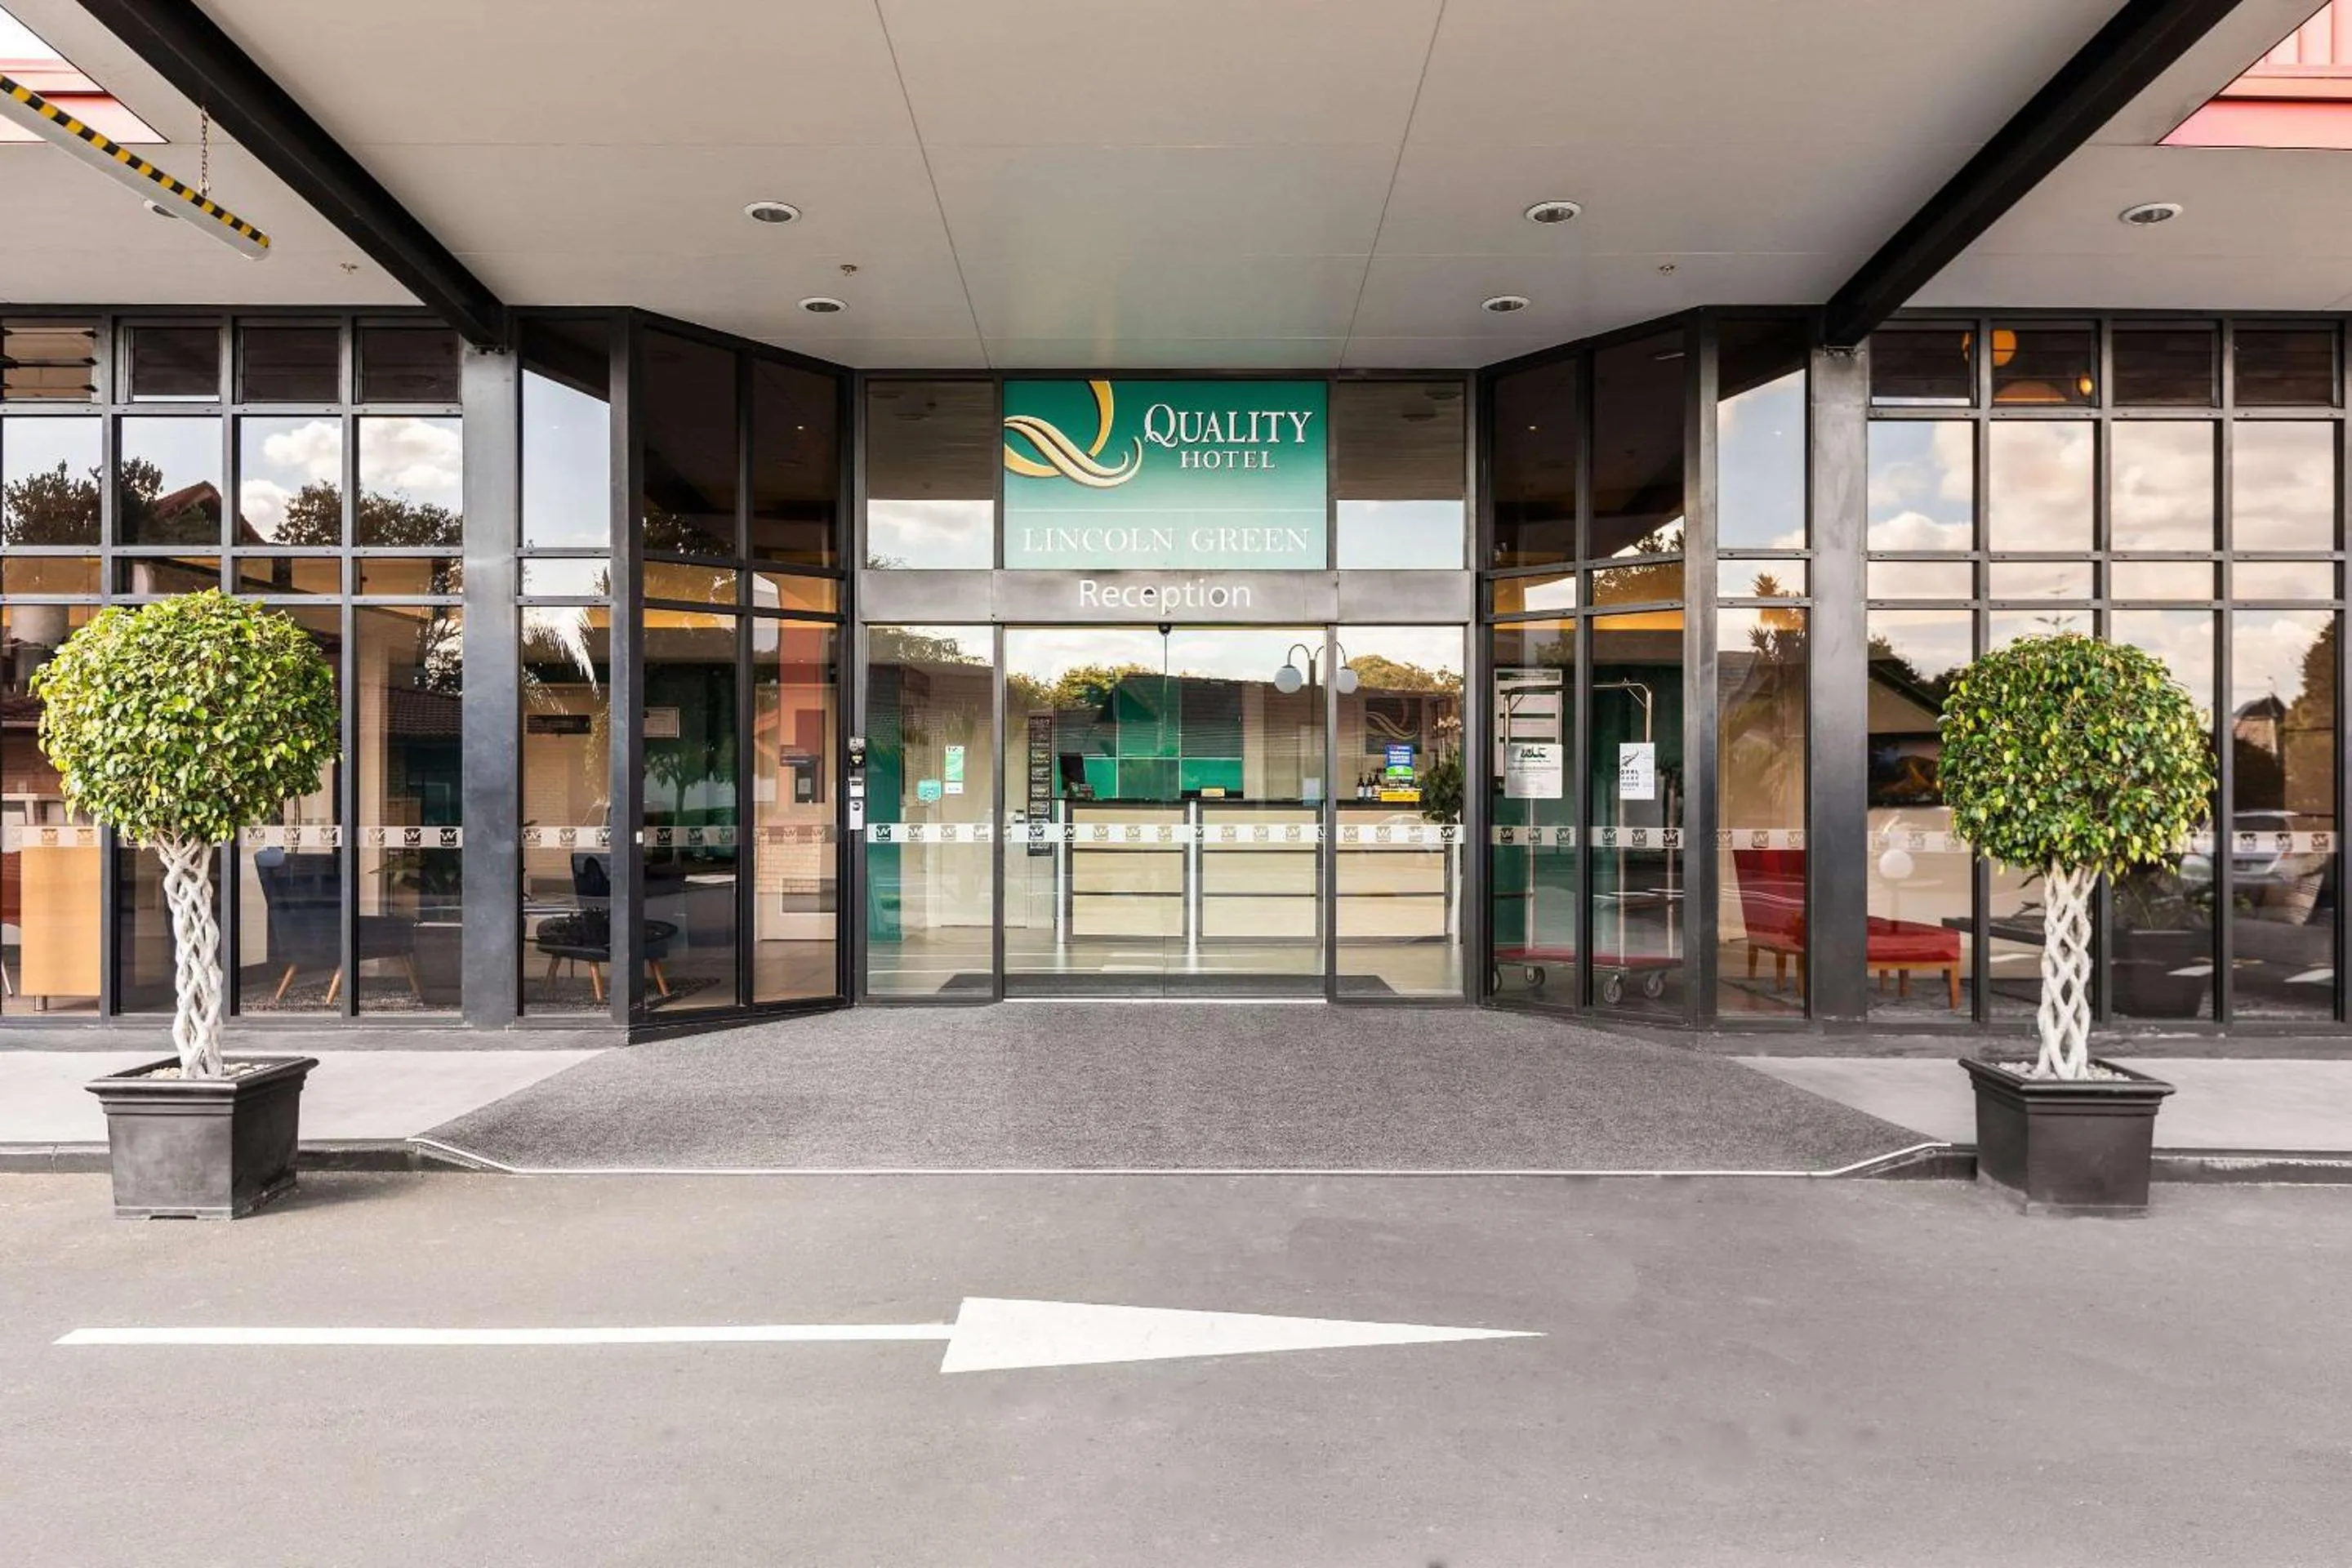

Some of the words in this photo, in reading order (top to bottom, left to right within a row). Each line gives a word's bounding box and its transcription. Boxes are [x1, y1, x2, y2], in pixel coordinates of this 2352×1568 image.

[1144, 403, 1312, 448] QUALITY
[1180, 451, 1276, 470] HOTEL
[1022, 527, 1176, 553] LINCOLN
[1191, 527, 1311, 553] GREEN
[1079, 579, 1251, 615] Reception
